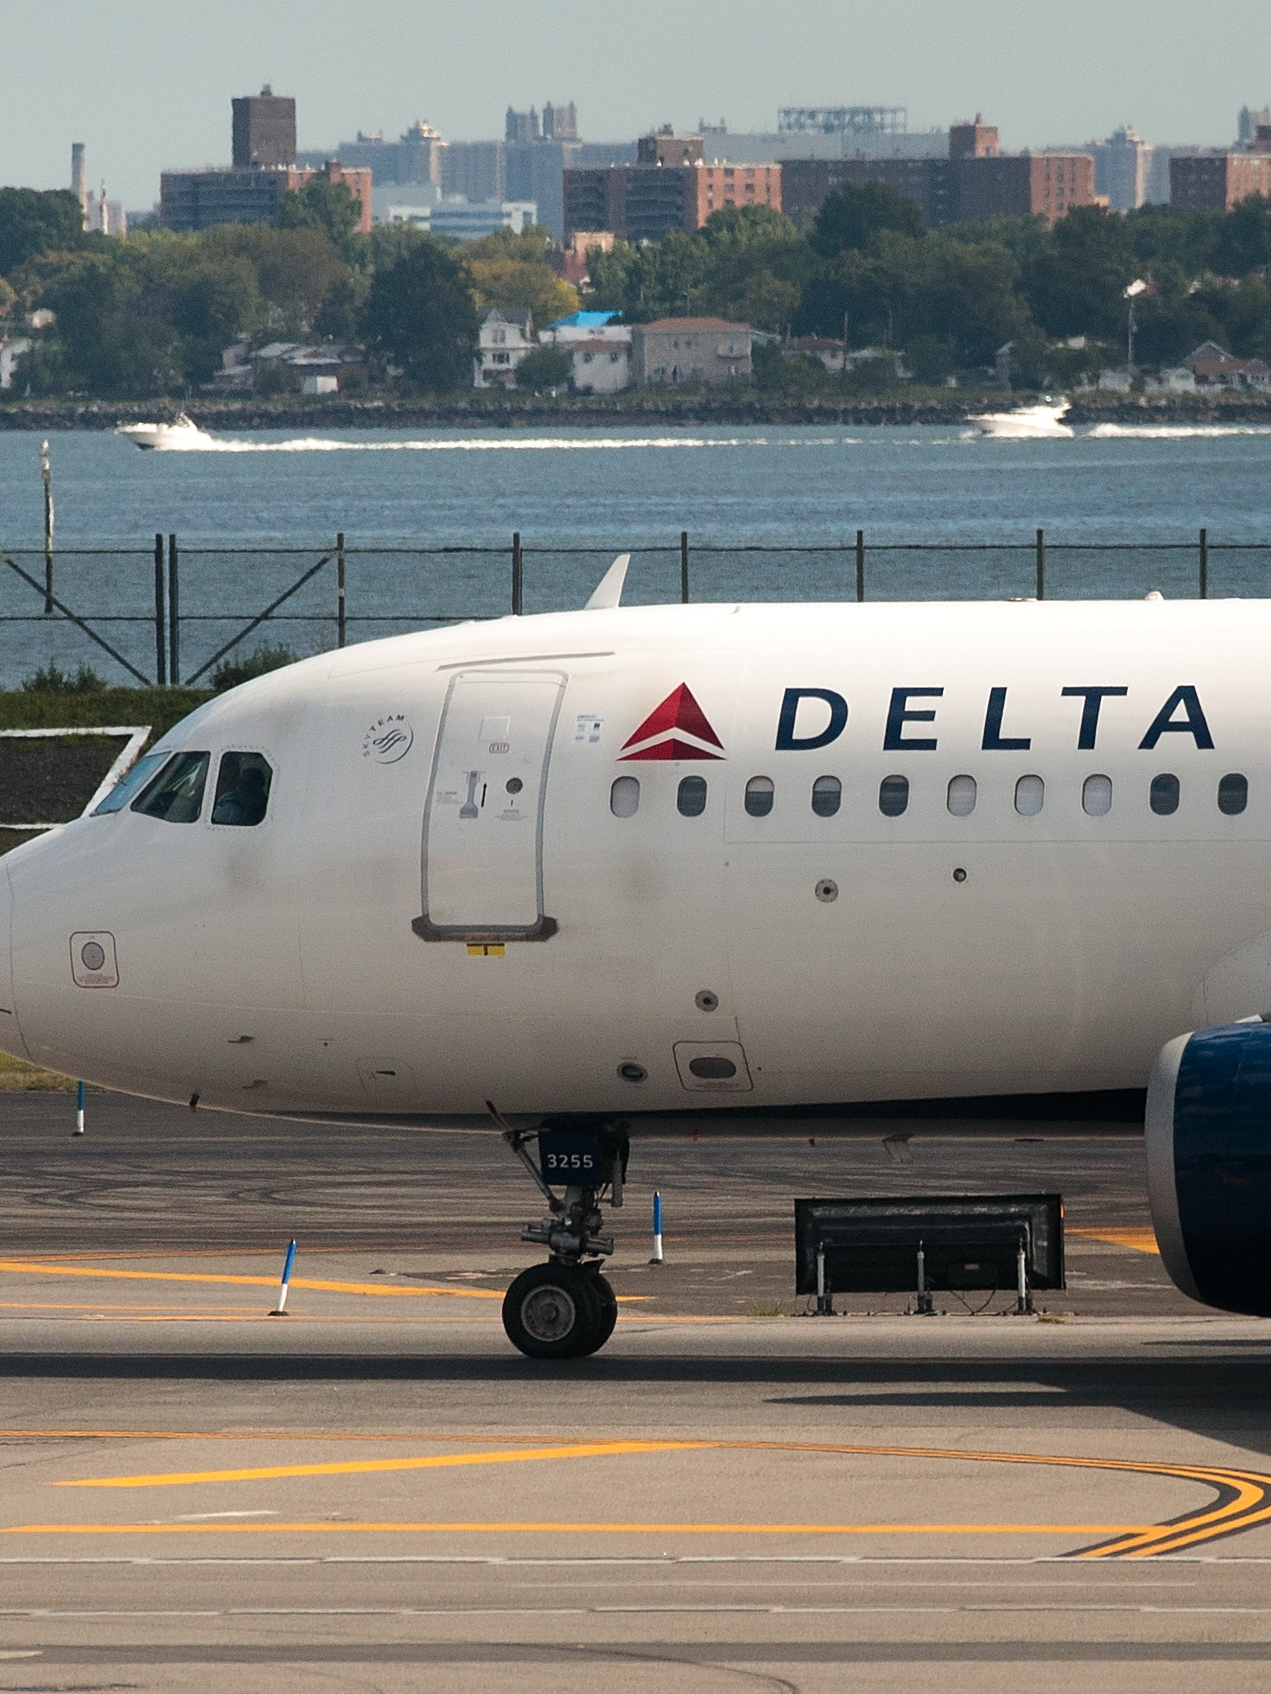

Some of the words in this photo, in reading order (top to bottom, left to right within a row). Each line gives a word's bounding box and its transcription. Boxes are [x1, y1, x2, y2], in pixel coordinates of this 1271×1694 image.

[362, 714, 405, 758] SKYTEAM
[775, 685, 1215, 751] DELTA
[546, 1153, 594, 1169] 3255
